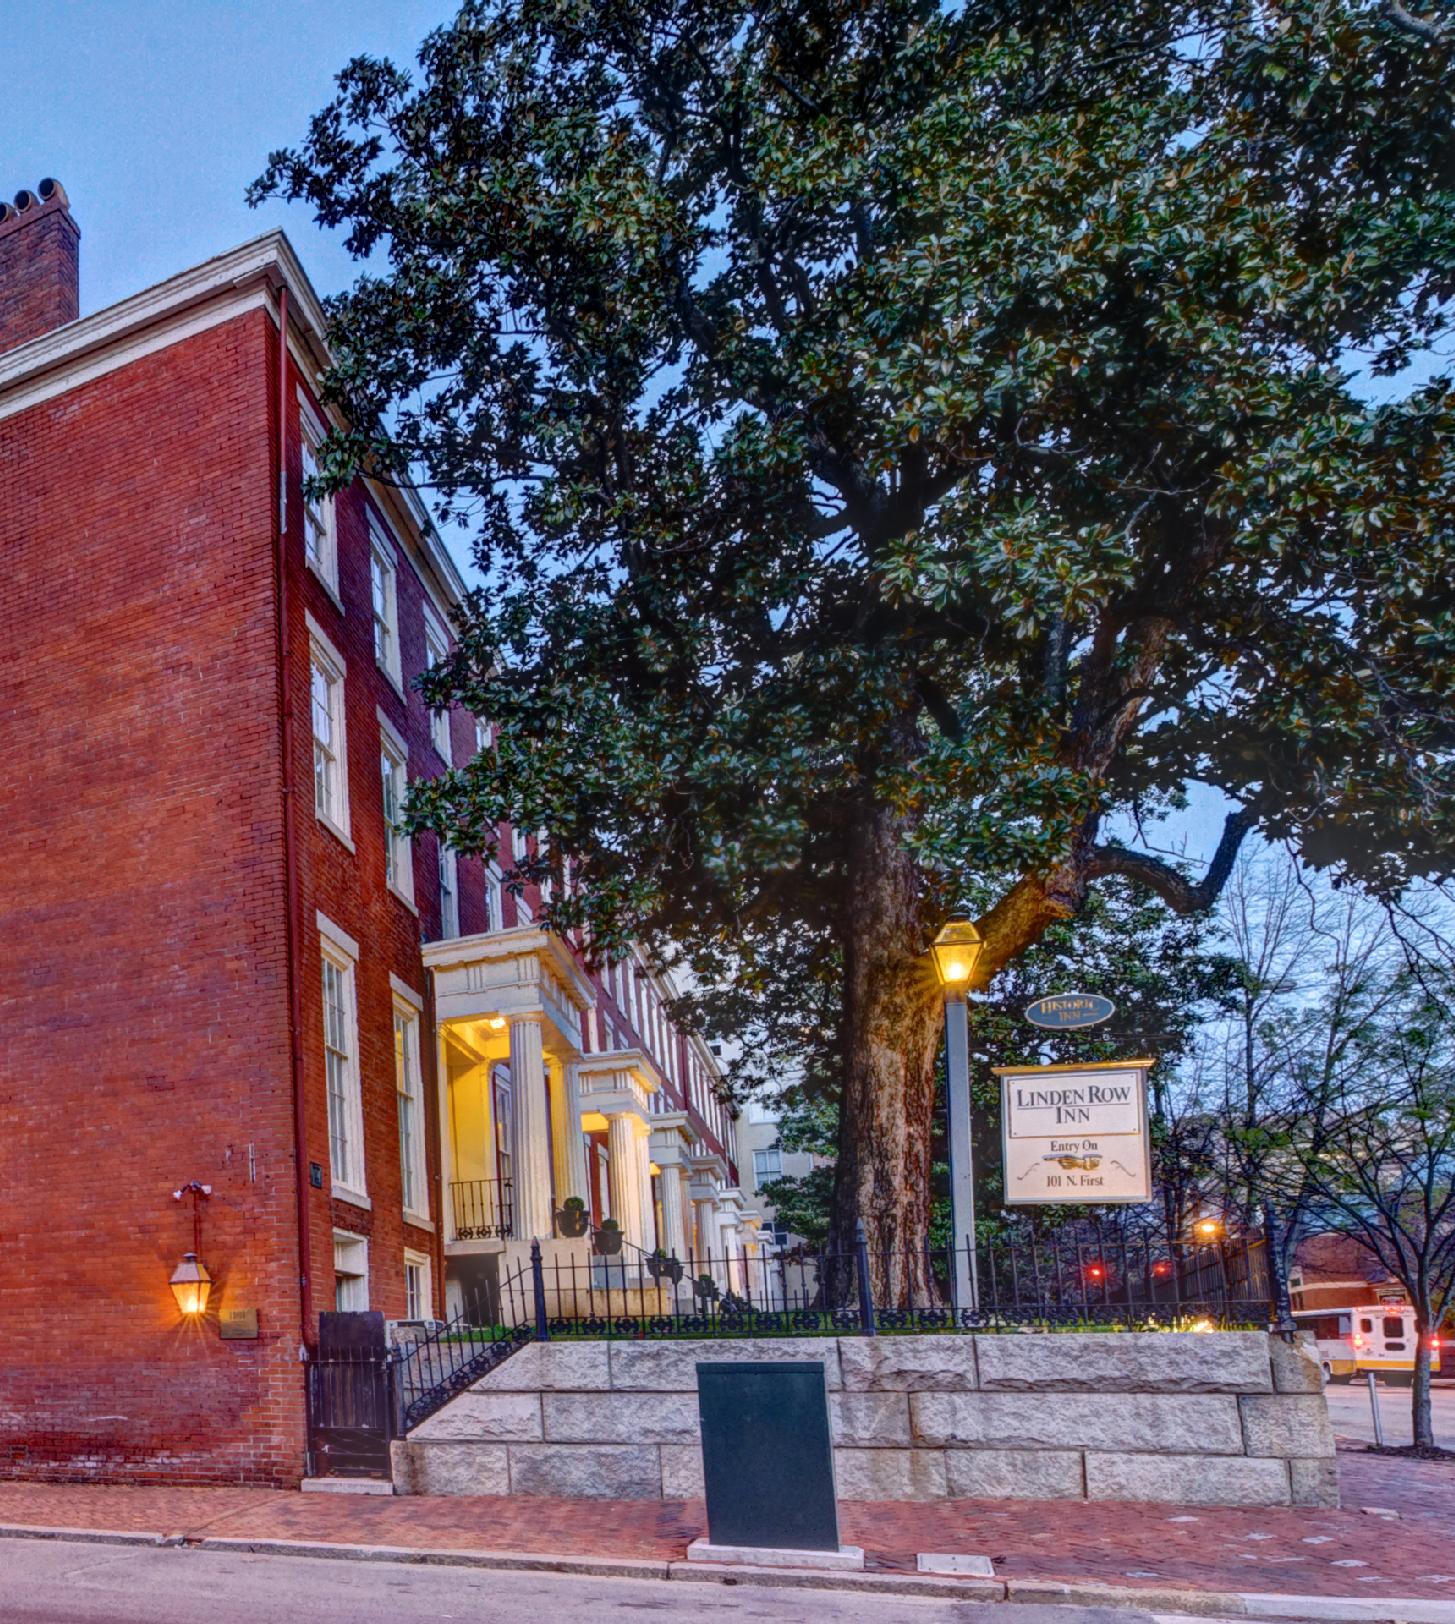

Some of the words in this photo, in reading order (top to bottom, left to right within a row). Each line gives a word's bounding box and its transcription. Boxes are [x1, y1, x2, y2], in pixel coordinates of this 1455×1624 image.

[1017, 1089, 1084, 1107] LINDEN
[1088, 1085, 1131, 1103] ROW
[1056, 1106, 1090, 1124] INN
[1050, 1141, 1080, 1153] Entry
[1082, 1139, 1098, 1151] On
[1047, 1175, 1062, 1187] 101
[1080, 1174, 1104, 1186] First
